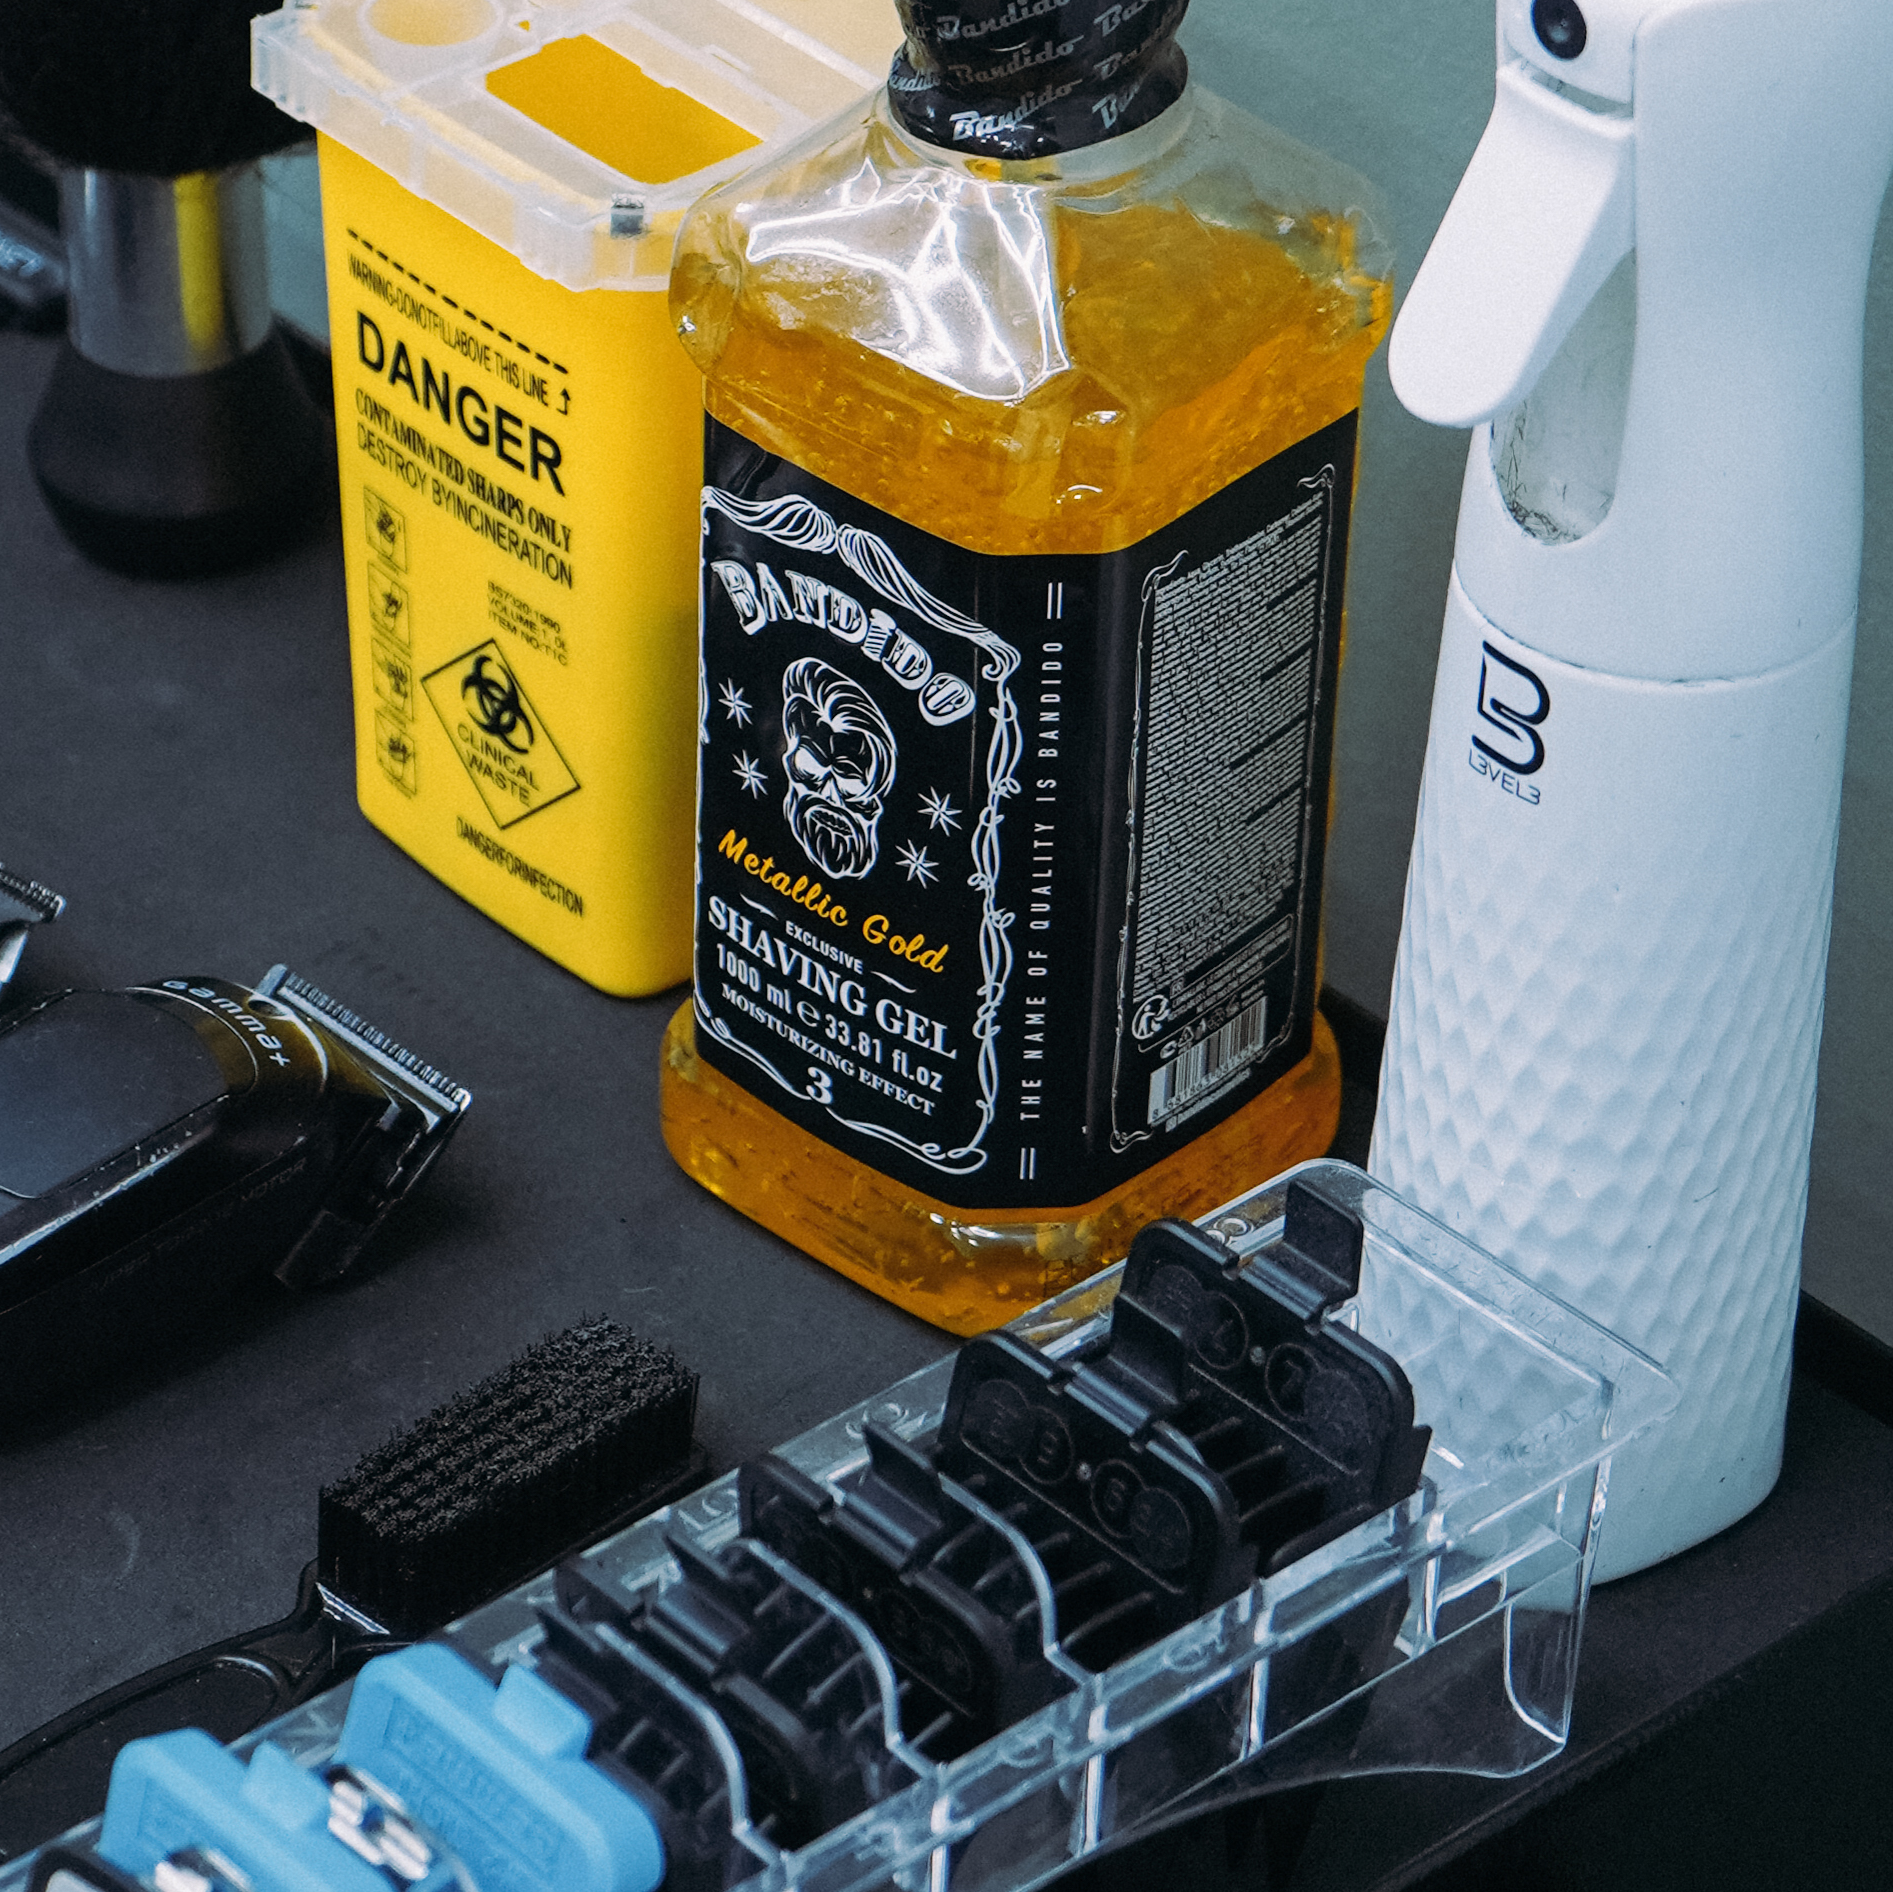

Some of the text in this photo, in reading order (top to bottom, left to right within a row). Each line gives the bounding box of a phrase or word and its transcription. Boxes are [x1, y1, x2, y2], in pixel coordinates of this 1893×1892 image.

[948, 34, 1085, 85] Bandido
[949, 78, 1084, 141] Bandido
[356, 309, 566, 498] DANGER
[494, 351, 521, 389] THIS
[522, 365, 550, 407] LINE
[355, 387, 572, 554] CONTAMINATED SHARPS ONLY
[357, 418, 428, 496] DESTROY
[710, 559, 977, 727] BANDIDO
[458, 722, 540, 792] CLINICAL
[466, 748, 532, 808] WASTE
[718, 829, 949, 973] Metallic Gold
[1020, 642, 1063, 1121] THE NAME OF QUALITY IS BANDIDO
[708, 895, 958, 1060] SHAVING GEL
[785, 919, 864, 975] EXCLUSIVE
[162, 980, 291, 1067] Gamma+
[716, 943, 762, 993] 1000
[766, 982, 792, 1015] ml
[824, 1014, 883, 1064] 33.81
[891, 1048, 943, 1093] fl.oz
[721, 982, 936, 1116] MOISTURIZING EFFECT
[805, 1066, 834, 1105] 3
